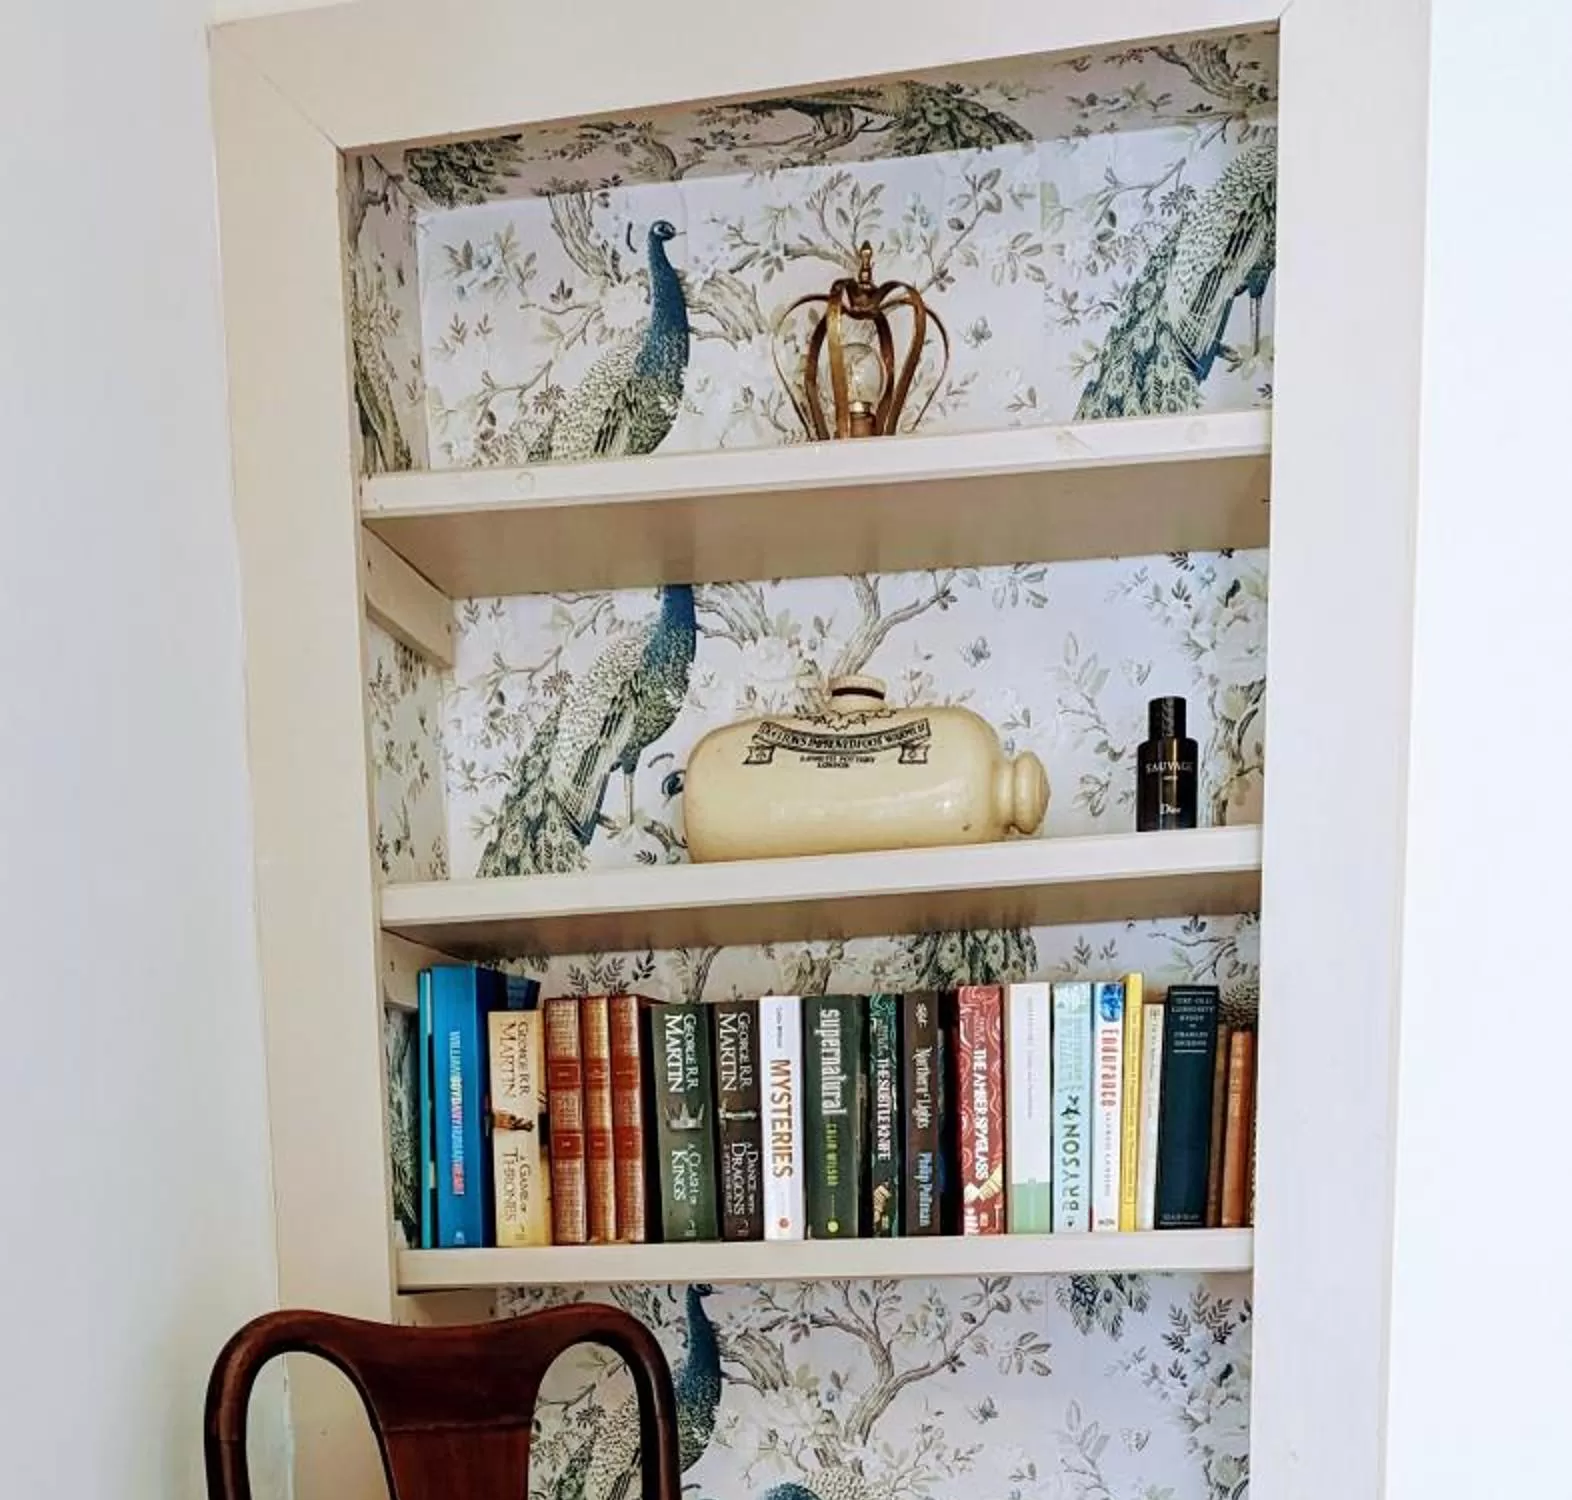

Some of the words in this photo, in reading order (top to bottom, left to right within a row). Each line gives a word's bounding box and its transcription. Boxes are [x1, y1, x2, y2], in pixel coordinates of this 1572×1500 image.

[1145, 761, 1193, 775] SAUVAGE
[499, 1021, 517, 1097] MARTIN
[664, 1013, 685, 1093] MARTIN
[683, 1013, 697, 1065] GEORGE
[719, 1013, 737, 1092] MARTIN
[737, 1012, 751, 1063] GEORGE
[814, 1008, 848, 1117] supernatural
[912, 1046, 932, 1093] Northern
[973, 1048, 987, 1067] THE
[1101, 1028, 1119, 1107] Endurance
[769, 1059, 794, 1179] MYSTERIES
[973, 1068, 988, 1115] AMBER
[671, 1150, 687, 1201] KINGS
[731, 1142, 746, 1215] DRAGONS
[975, 1115, 989, 1180] SPYGLASS
[1062, 1124, 1081, 1211] BRYSON
[502, 1148, 519, 1223] THRONES
